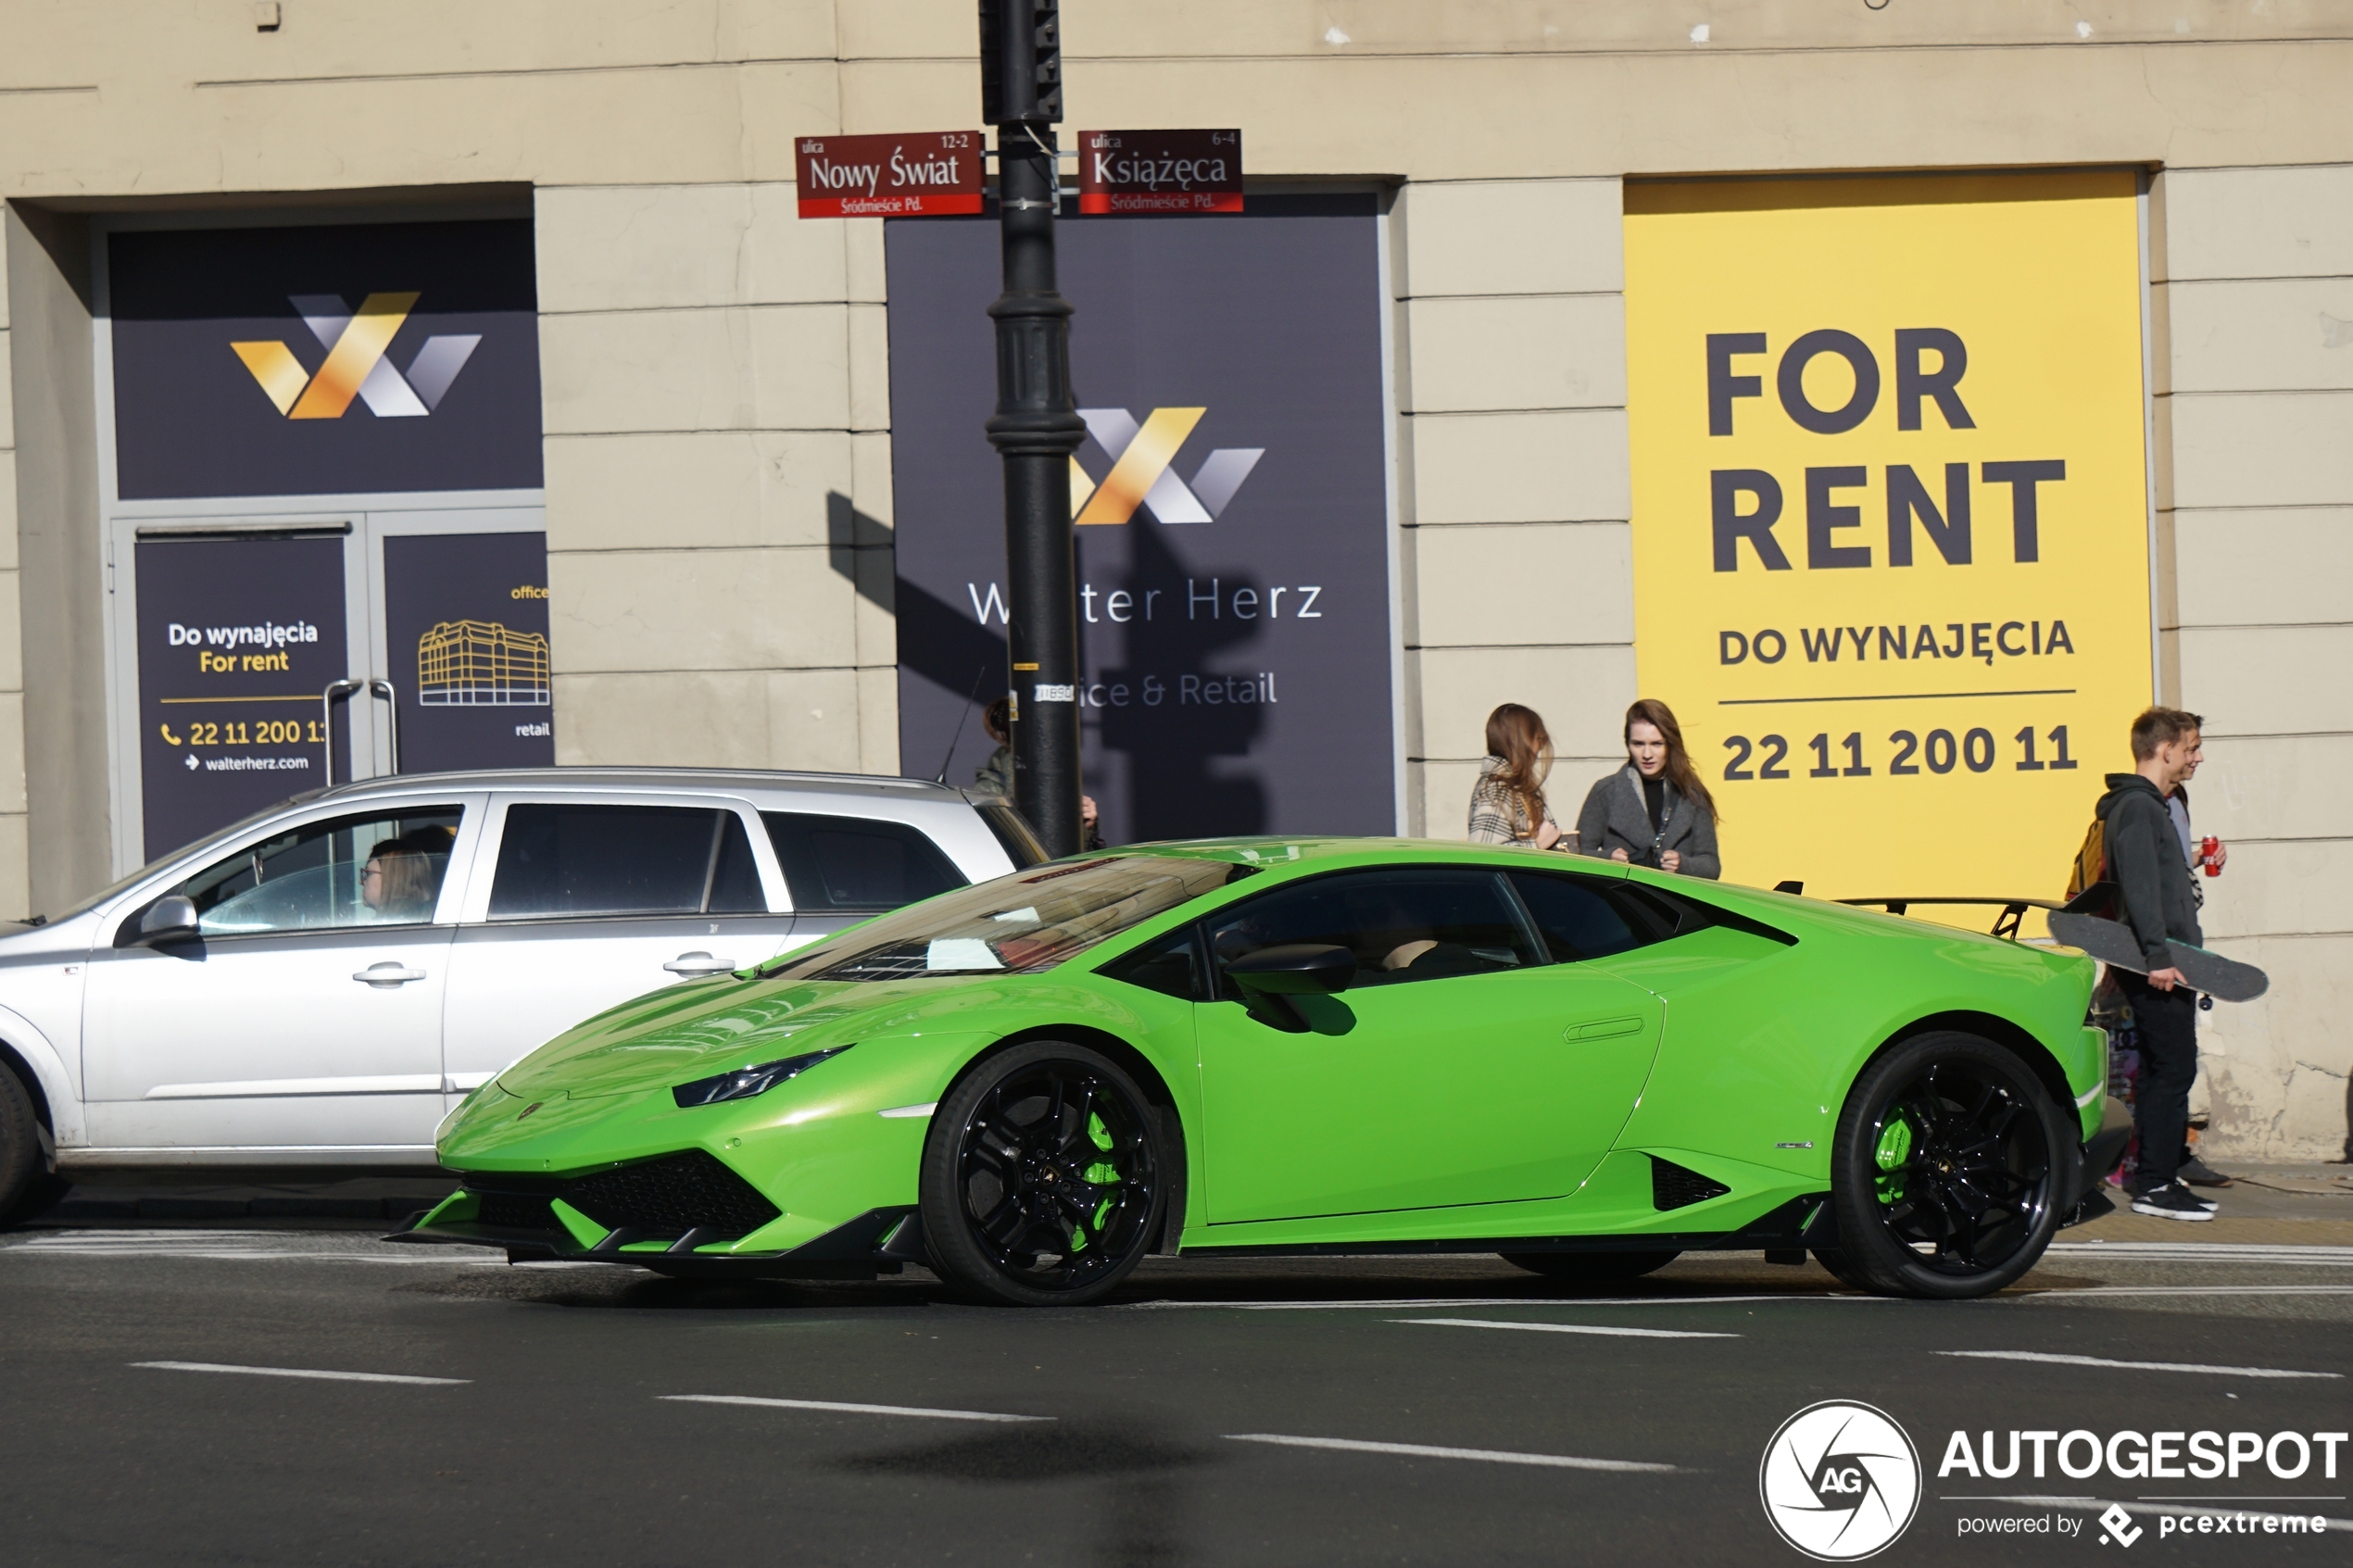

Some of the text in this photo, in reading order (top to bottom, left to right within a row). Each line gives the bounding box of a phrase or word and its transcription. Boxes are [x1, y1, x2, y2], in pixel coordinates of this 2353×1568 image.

[802, 140, 824, 154] ulica
[940, 134, 969, 149] 12-2
[1091, 134, 1122, 149] ulica
[1212, 132, 1236, 145] 6-4
[811, 145, 960, 197] Nowy Świat
[1094, 151, 1227, 192] Książęca
[841, 197, 923, 214] Śródmieście Pd.
[1111, 194, 1214, 210] Śródmieście Pd.
[1705, 327, 1977, 437] FOR
[1710, 459, 2066, 572] RENT
[511, 585, 549, 599] office
[968, 578, 1323, 625] Wter Herz
[169, 621, 318, 648] Do wynajęcia
[1719, 620, 2075, 667] DO WYNAJĘCIA
[200, 650, 289, 672] For rent
[1142, 675, 1166, 707] &
[1181, 672, 1277, 705] Retail
[190, 722, 219, 746] 22
[225, 721, 250, 745] 11
[256, 721, 301, 744] 200
[515, 722, 550, 737] retail
[206, 755, 308, 771] walterherz.com
[1722, 725, 2078, 782] 22 11 200 11
